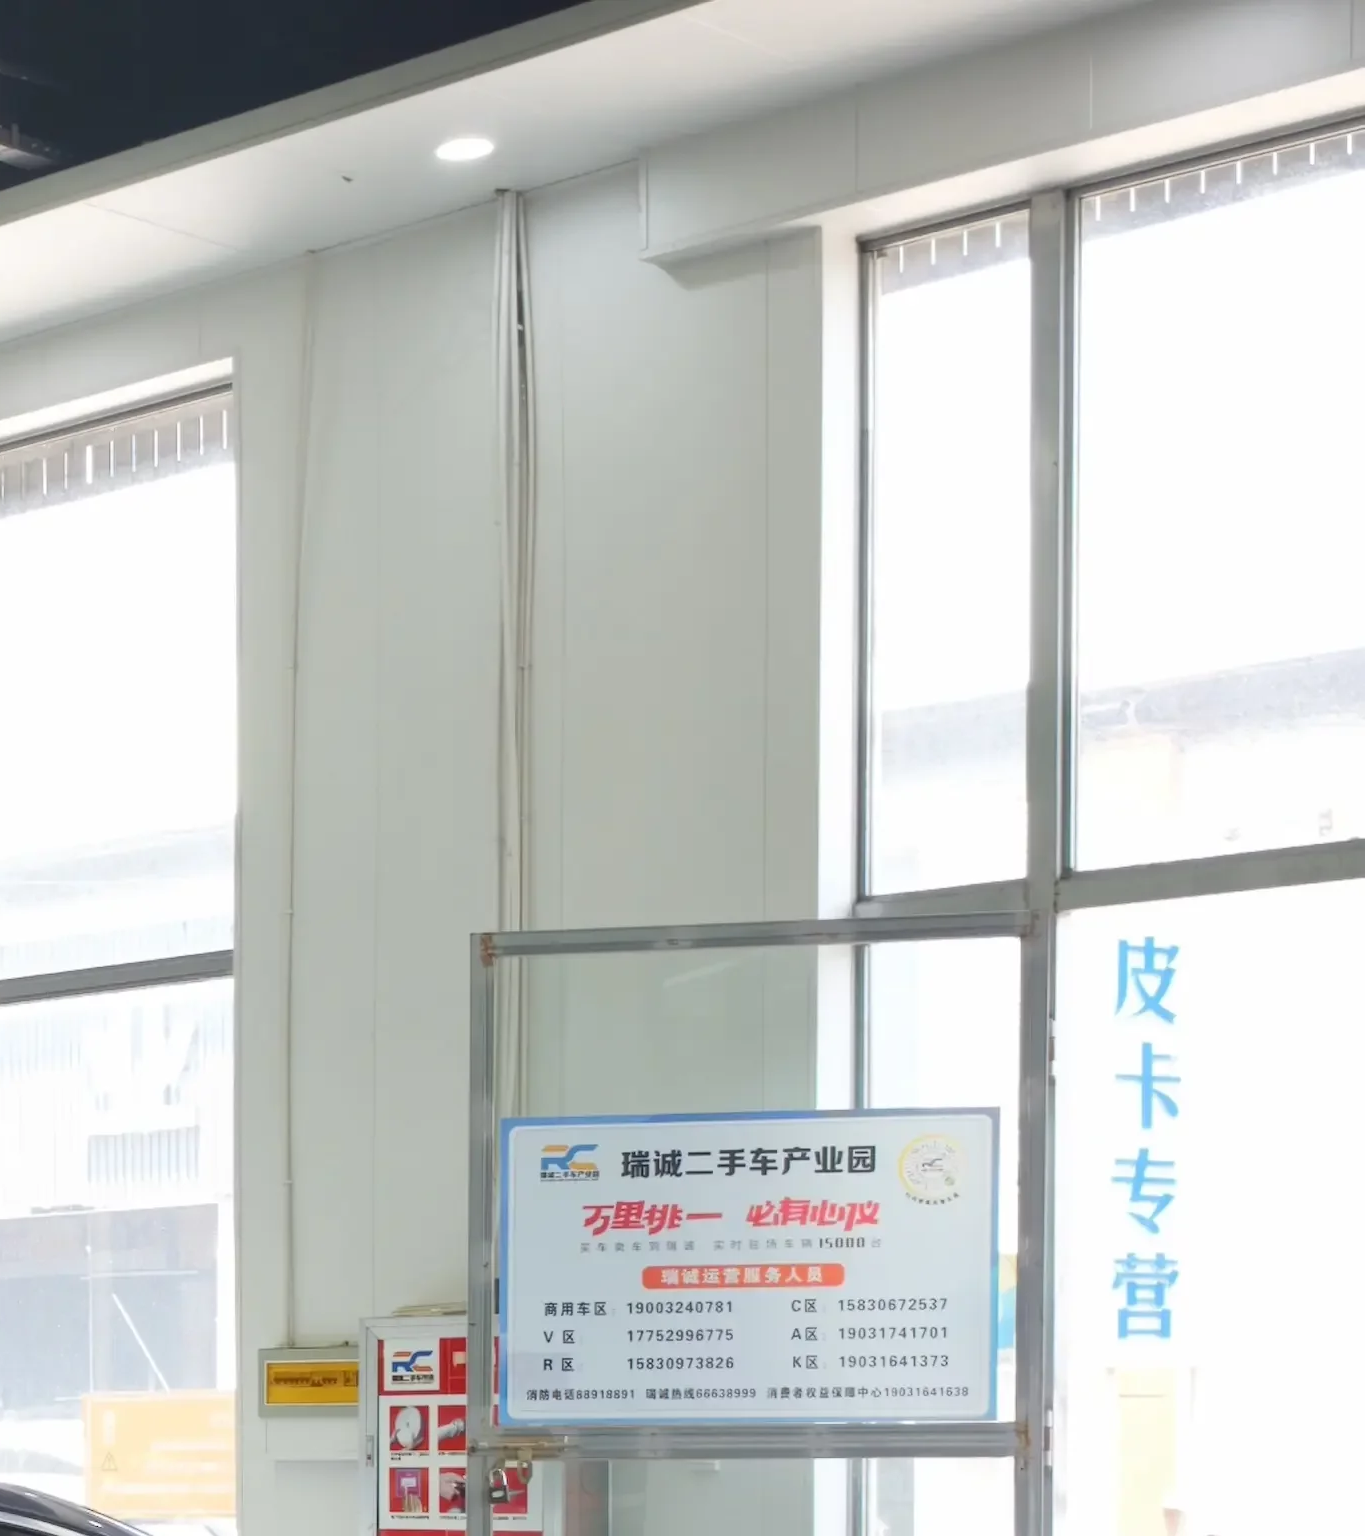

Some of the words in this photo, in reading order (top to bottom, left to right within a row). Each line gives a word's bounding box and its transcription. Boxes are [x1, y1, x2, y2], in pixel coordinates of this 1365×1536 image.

[1111, 936, 1181, 1339] 皮卡专营
[621, 1145, 876, 1179] 瑞诚二手车产业园
[582, 1201, 722, 1236] 万里挑一
[745, 1197, 880, 1231] 必有心仪
[661, 1266, 823, 1285] 瑞诚运营服务人员
[627, 1301, 733, 1314] 19003240781
[838, 1298, 948, 1311] 15830672537
[627, 1329, 734, 1342] 17752996775
[838, 1327, 948, 1340] 19031741701
[627, 1357, 734, 1370] 15830973826
[839, 1355, 949, 1368] 19031641373
